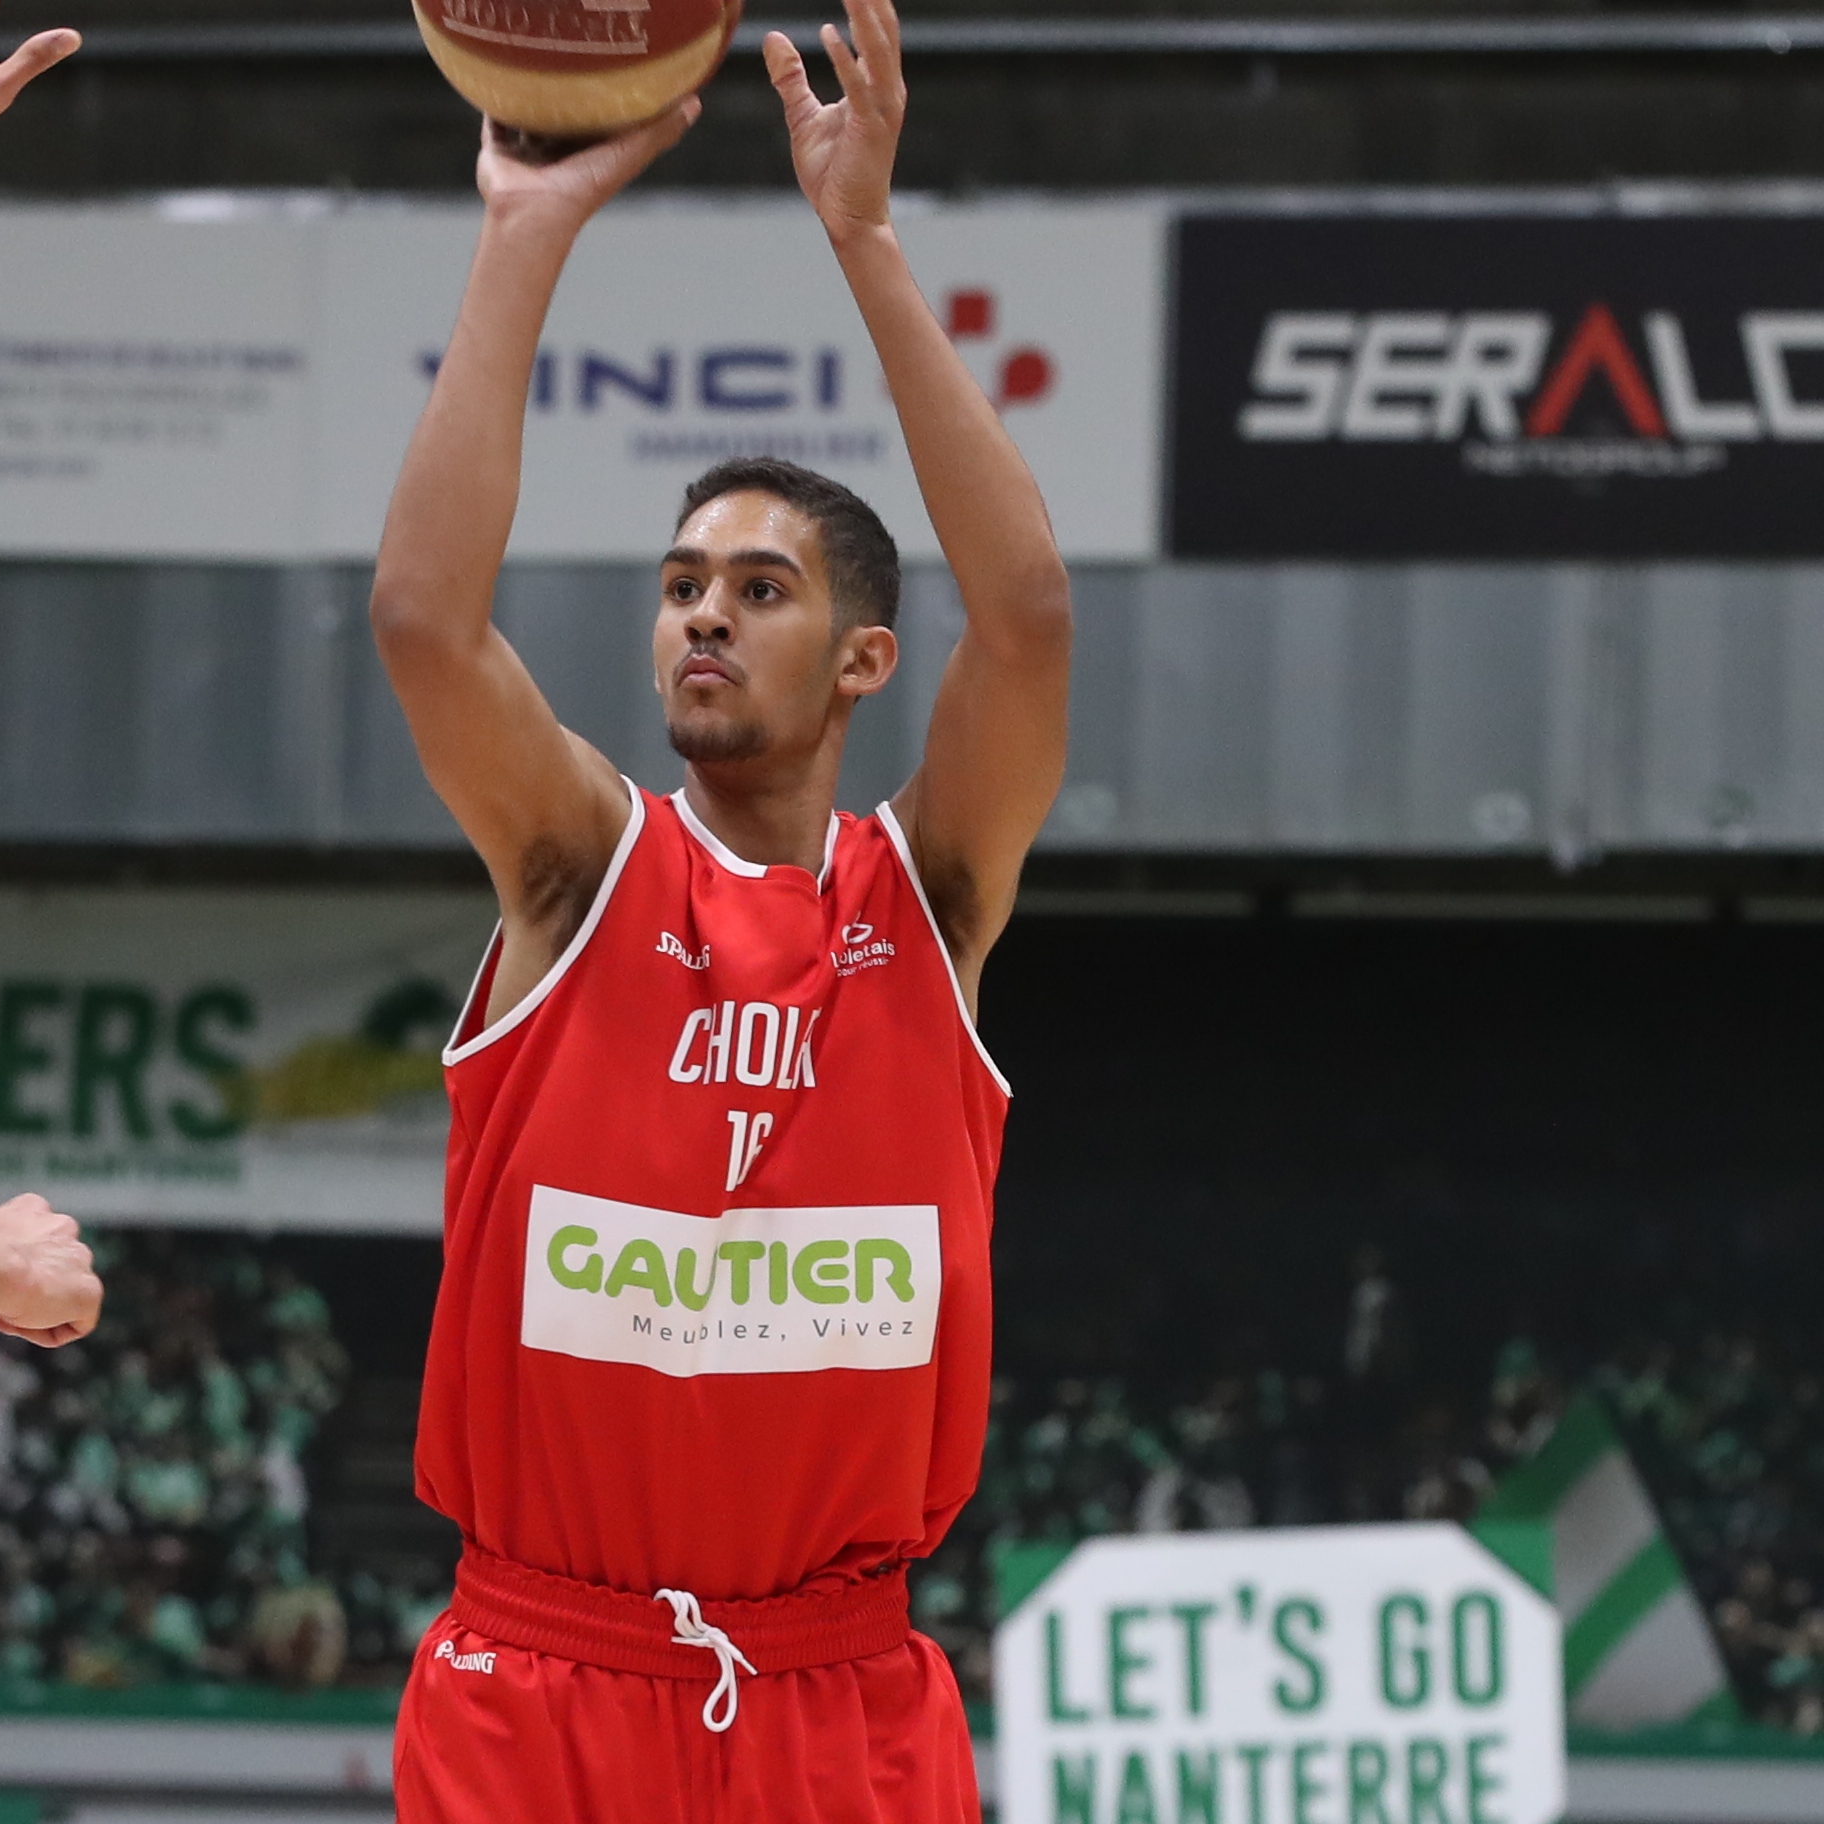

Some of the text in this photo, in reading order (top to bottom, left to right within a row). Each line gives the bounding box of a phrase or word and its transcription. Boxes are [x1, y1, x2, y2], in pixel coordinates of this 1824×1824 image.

[419, 345, 841, 410] INCI
[547, 1225, 915, 1312] GAUTIER
[812, 1318, 914, 1339] Vivez
[1044, 1583, 1504, 1723] LET'S GO
